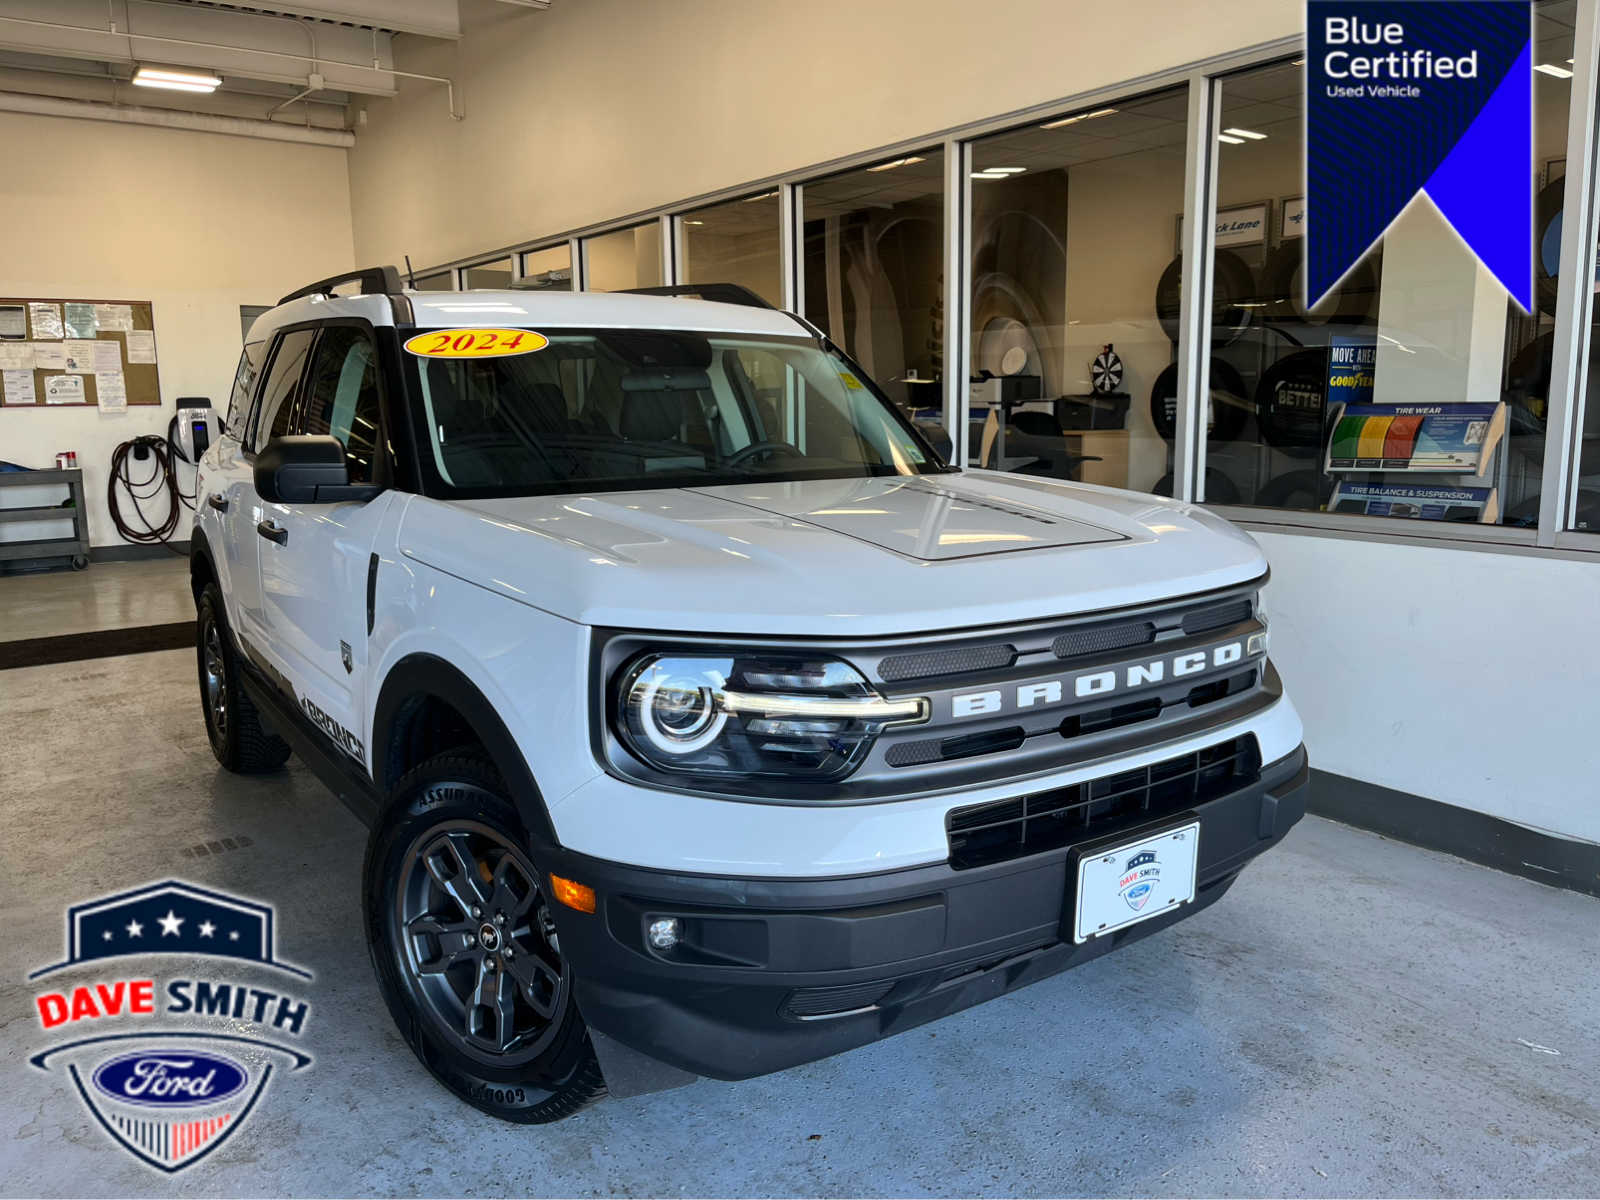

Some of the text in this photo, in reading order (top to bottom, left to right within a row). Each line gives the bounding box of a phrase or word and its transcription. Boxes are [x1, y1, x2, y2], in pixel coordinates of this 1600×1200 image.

[428, 332, 525, 353] 2024
[1332, 347, 1376, 364] MOVE AHEA
[1330, 372, 1376, 389] GOODYEA
[1278, 389, 1321, 410] BETTE
[1395, 407, 1442, 415] TIRE WEAR
[1351, 486, 1367, 495] TIRE
[1368, 487, 1407, 497] BALANCE
[1415, 489, 1473, 500] SUSPENSION
[951, 641, 1242, 719] BRONCO
[1119, 867, 1160, 888] DAVE SMITH
